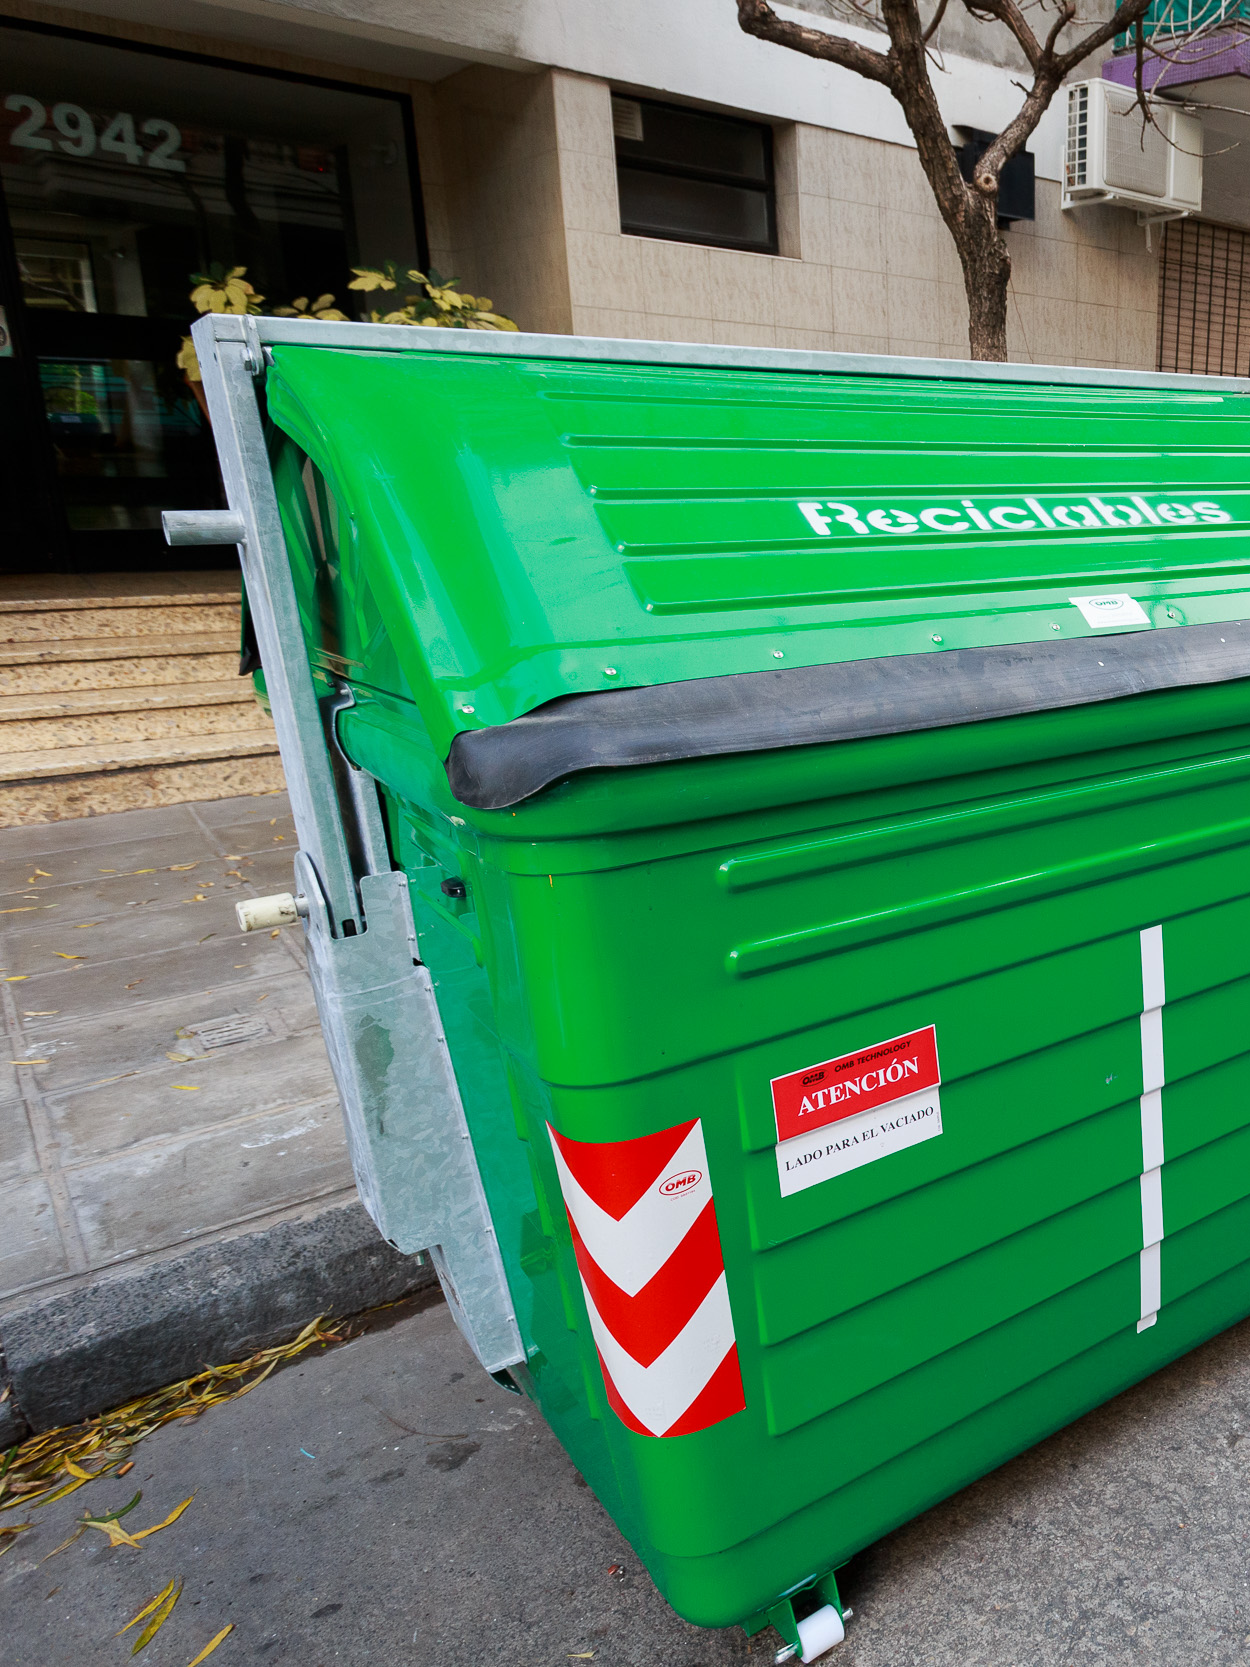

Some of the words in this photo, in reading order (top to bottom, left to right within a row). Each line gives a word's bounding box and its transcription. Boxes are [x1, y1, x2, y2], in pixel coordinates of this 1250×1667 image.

[4, 94, 187, 172] 2942
[797, 496, 1232, 536] Reciclables
[834, 1060, 855, 1073] OMB
[856, 1039, 912, 1065] TECHNOLOGY
[797, 1056, 919, 1117] ATENCIÓN
[802, 1071, 825, 1086] OMB
[785, 1149, 823, 1172] LADO
[825, 1136, 860, 1156] PARA
[862, 1128, 879, 1142] EL
[880, 1106, 934, 1134] VACIADO
[665, 1174, 696, 1192] OMB
